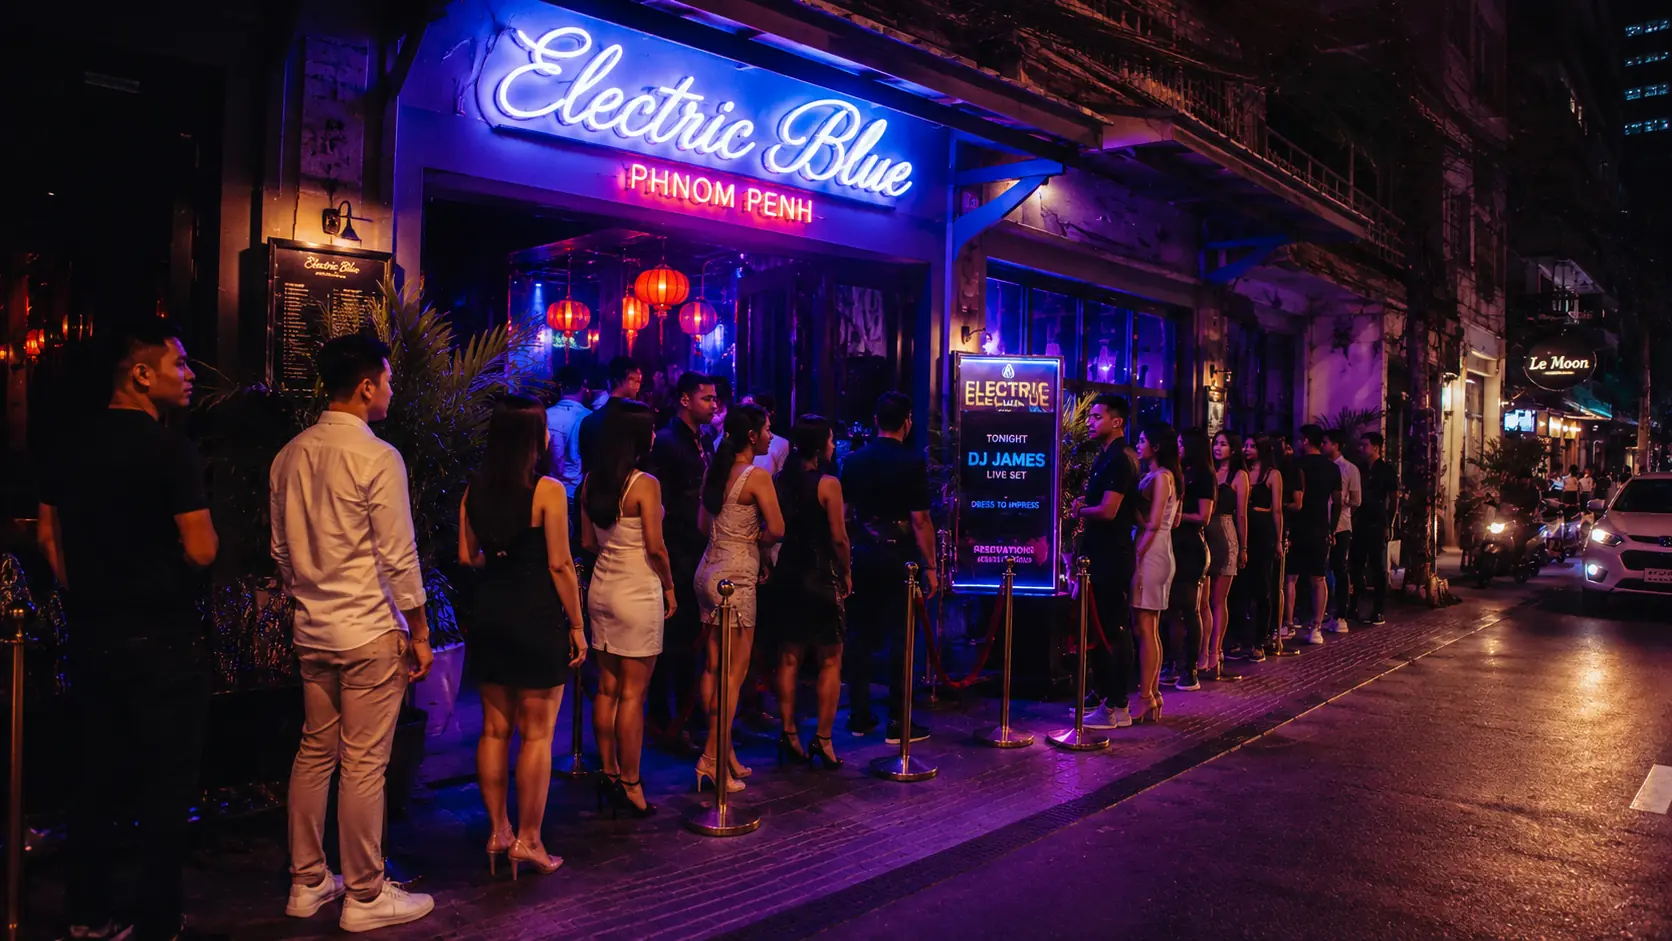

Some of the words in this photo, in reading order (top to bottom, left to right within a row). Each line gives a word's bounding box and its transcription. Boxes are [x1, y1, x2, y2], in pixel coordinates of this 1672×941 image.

[499, 27, 756, 159] Electric
[768, 99, 913, 197] Blue
[631, 163, 735, 208] PHNOM
[747, 188, 813, 223] PENH
[1529, 356, 1547, 370] Le
[1550, 356, 1590, 370] Moon
[987, 434, 1028, 443] TONIGHT
[968, 451, 987, 466] DJ
[992, 452, 1046, 467] JAMES
[987, 470, 1007, 479] LIVE
[1009, 471, 1027, 480] SET
[997, 501, 1007, 509] TO
